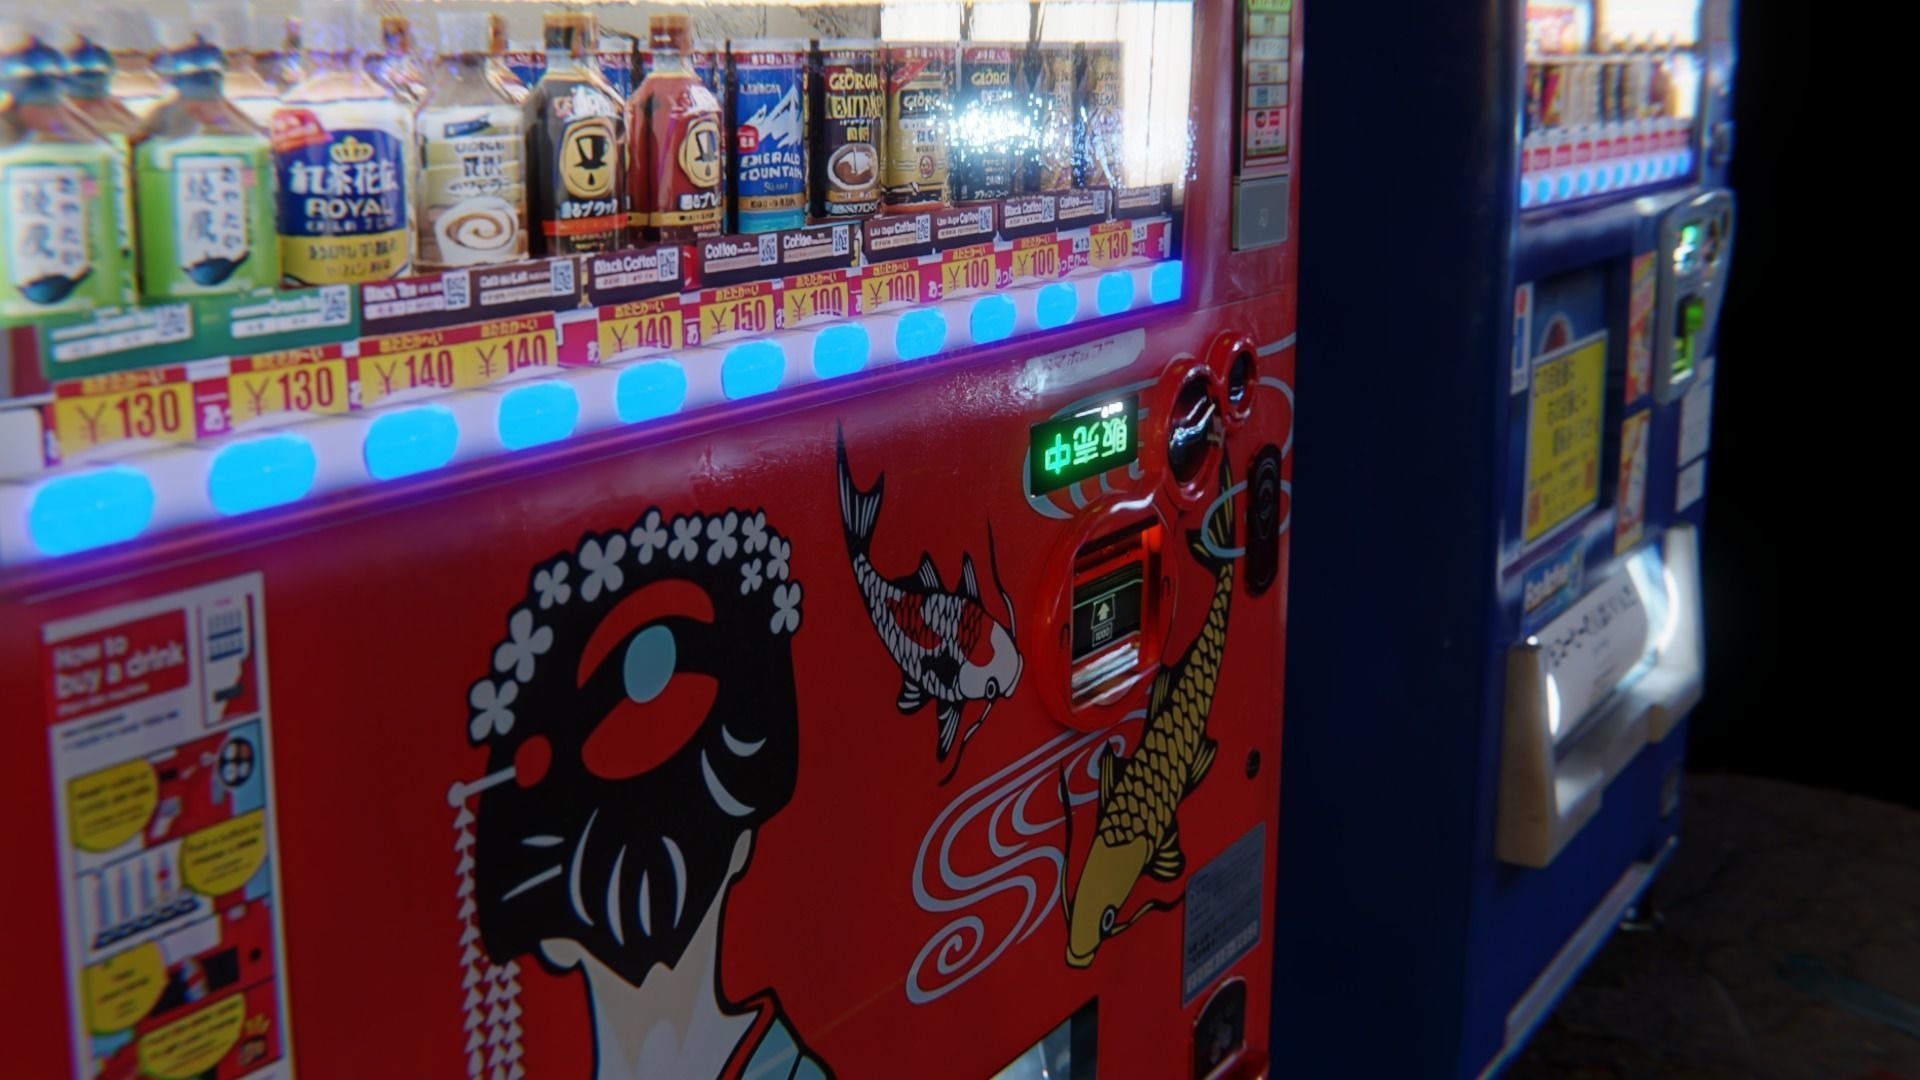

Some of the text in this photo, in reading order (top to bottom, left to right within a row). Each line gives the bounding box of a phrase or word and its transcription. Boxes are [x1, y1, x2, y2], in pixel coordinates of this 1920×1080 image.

[1017, 247, 1055, 277] ¥100
[1095, 231, 1129, 259] ¥130
[869, 273, 916, 309] ¥100
[948, 258, 990, 290] ¥100
[611, 315, 672, 352] ¥140
[710, 299, 766, 334] ¥150
[375, 350, 453, 396] ¥140
[477, 334, 548, 378] ¥140
[245, 367, 333, 415] ¥130
[77, 390, 181, 443] ¥130
[1045, 414, 1128, 475] 販売中
[105, 634, 128, 657] to
[56, 667, 102, 699] buy
[106, 662, 122, 684] a
[125, 641, 184, 678] drink
